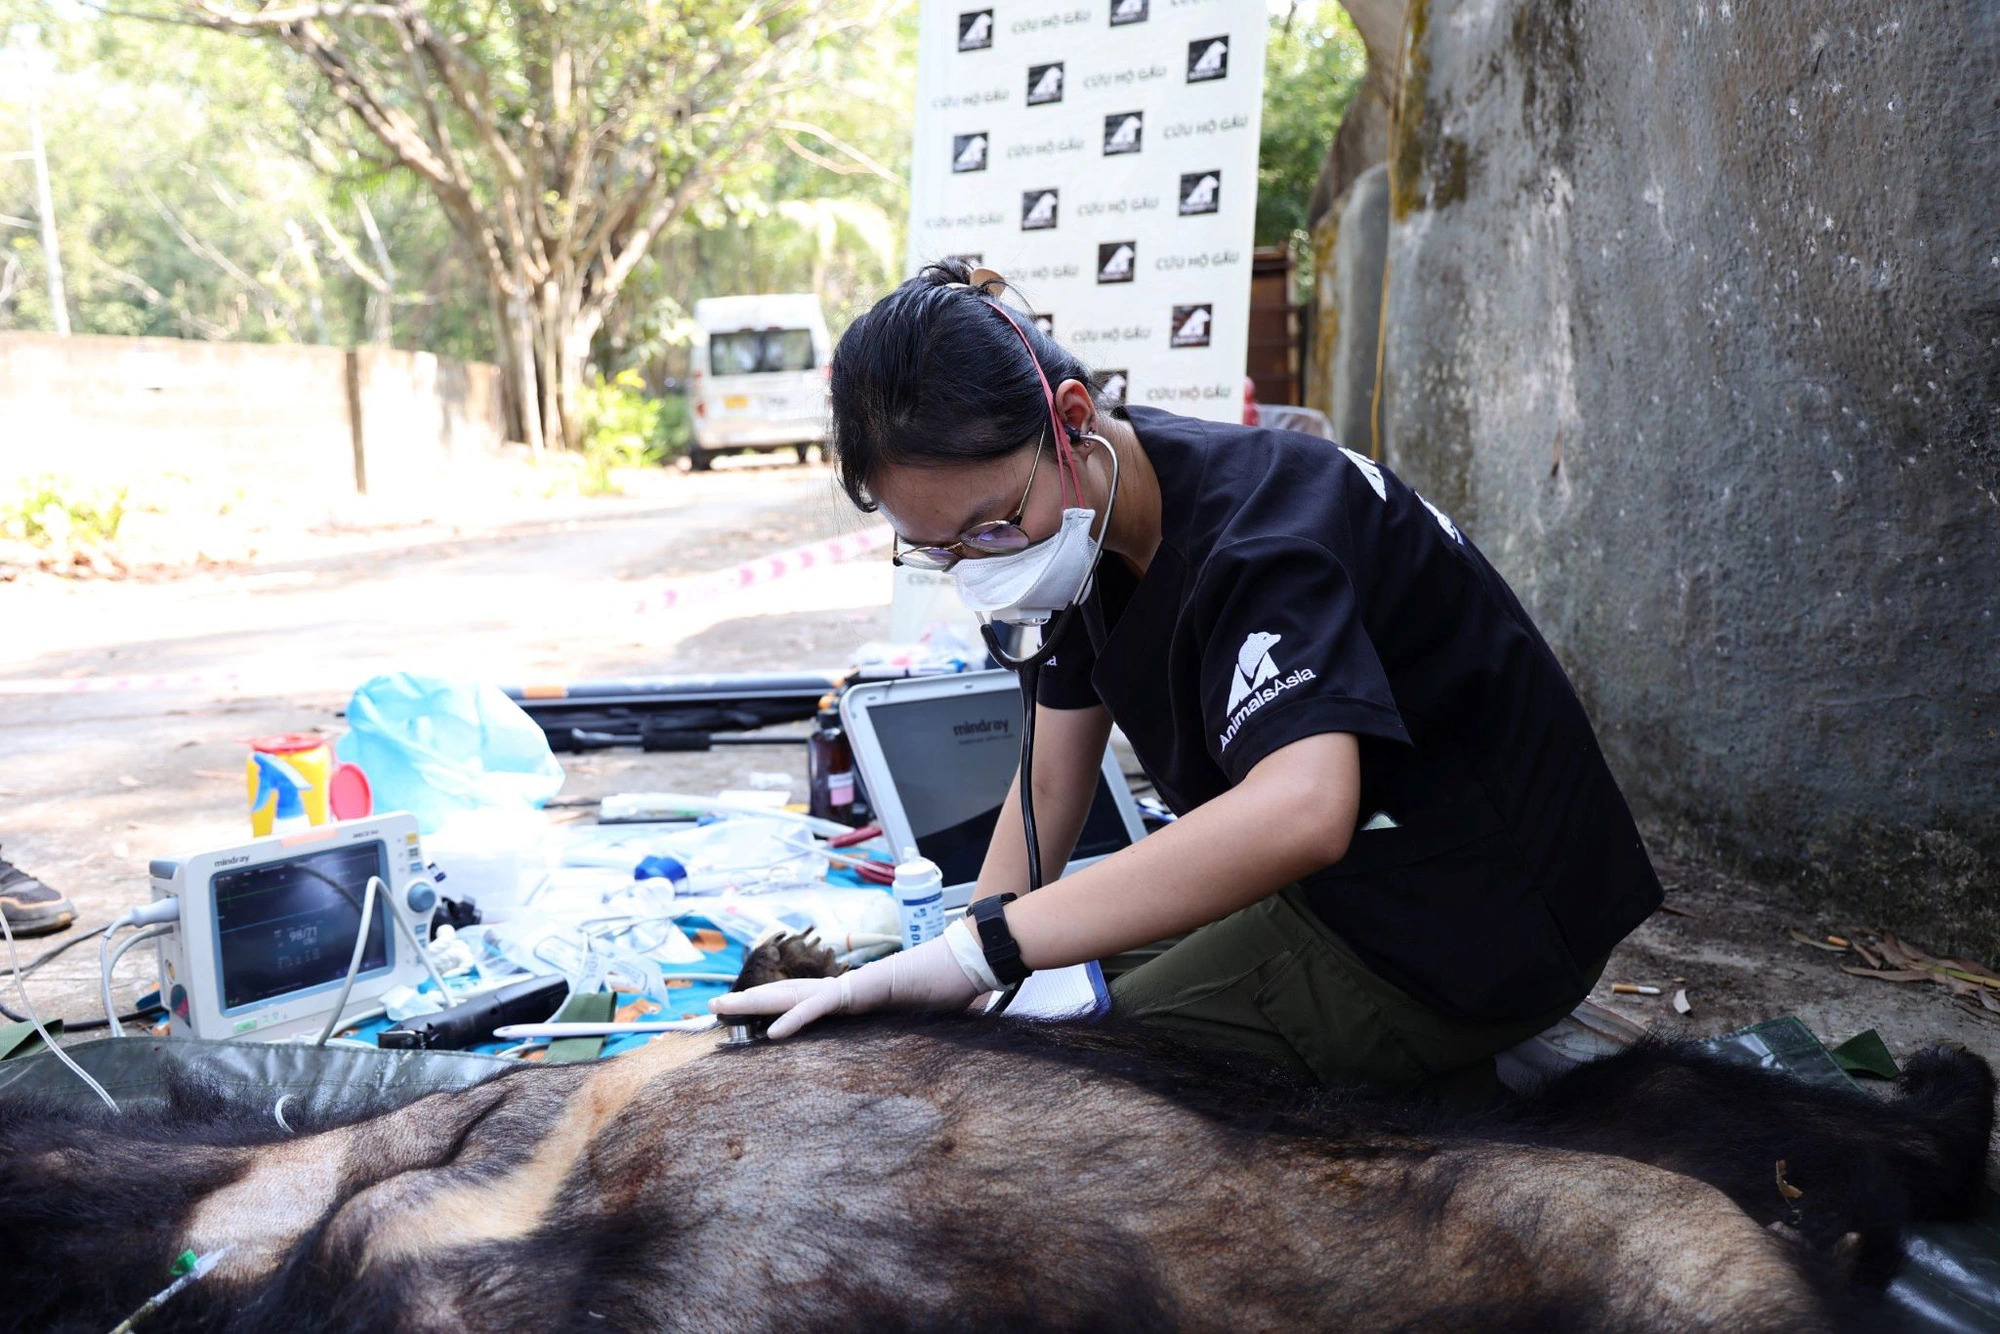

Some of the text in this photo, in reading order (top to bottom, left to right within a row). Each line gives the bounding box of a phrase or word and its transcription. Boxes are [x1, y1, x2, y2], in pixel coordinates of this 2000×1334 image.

[1218, 666, 1316, 754] AnimalsAsia
[953, 718, 1008, 736] mindray
[214, 856, 249, 868] mindray
